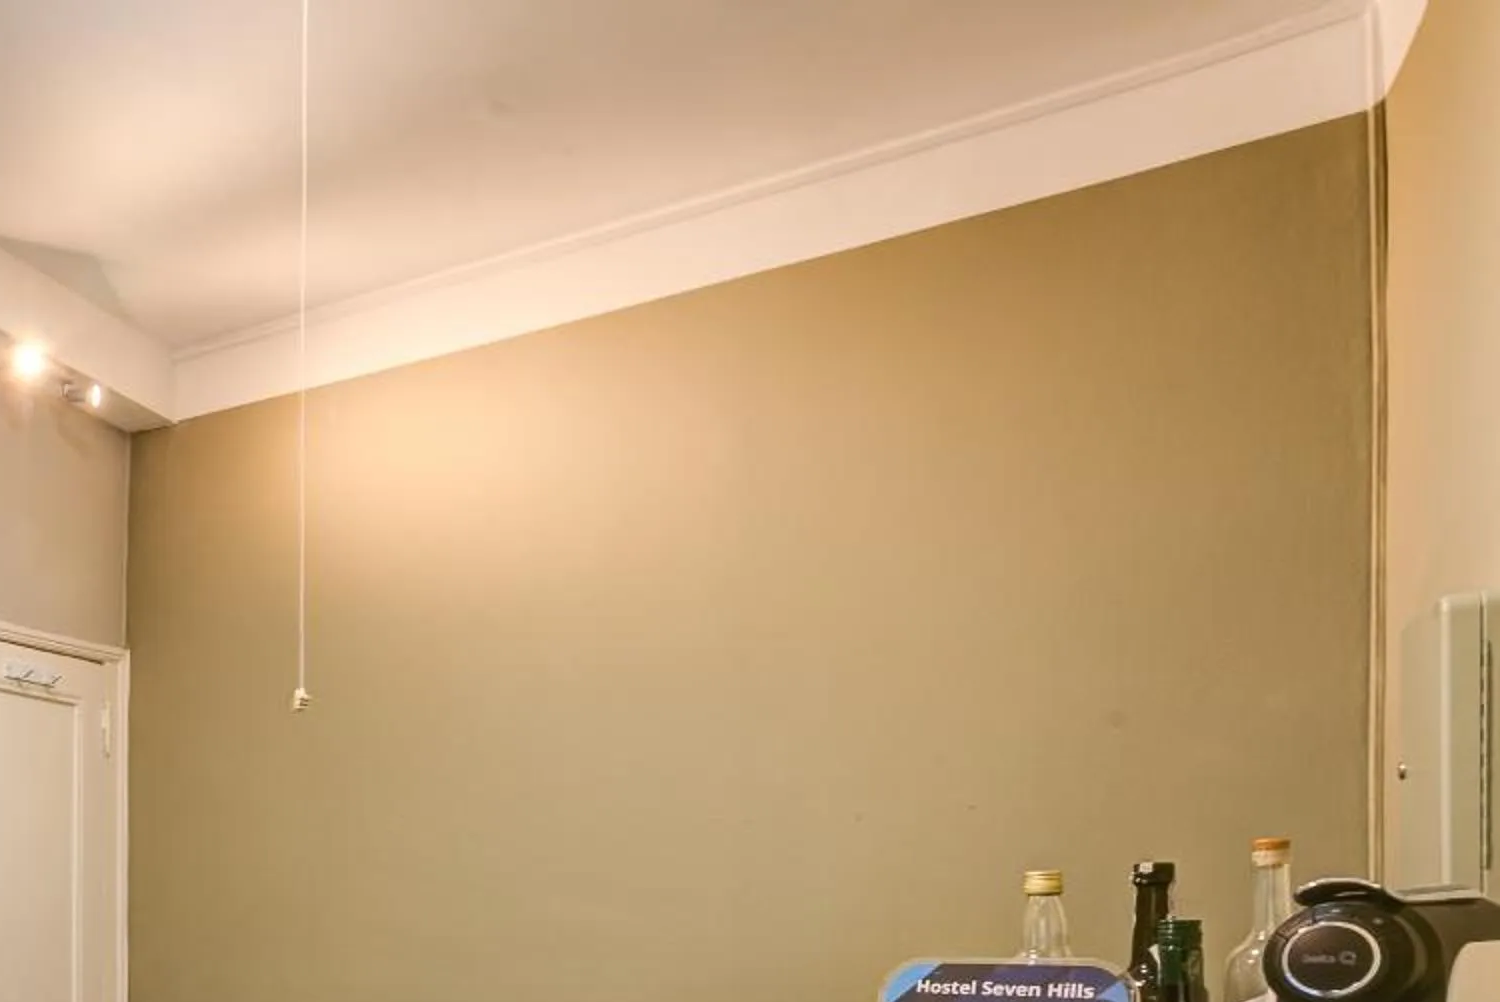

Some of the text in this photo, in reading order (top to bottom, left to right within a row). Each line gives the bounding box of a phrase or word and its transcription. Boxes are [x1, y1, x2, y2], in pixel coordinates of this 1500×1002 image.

[915, 978, 1095, 1000] Hostel Seven Hills
